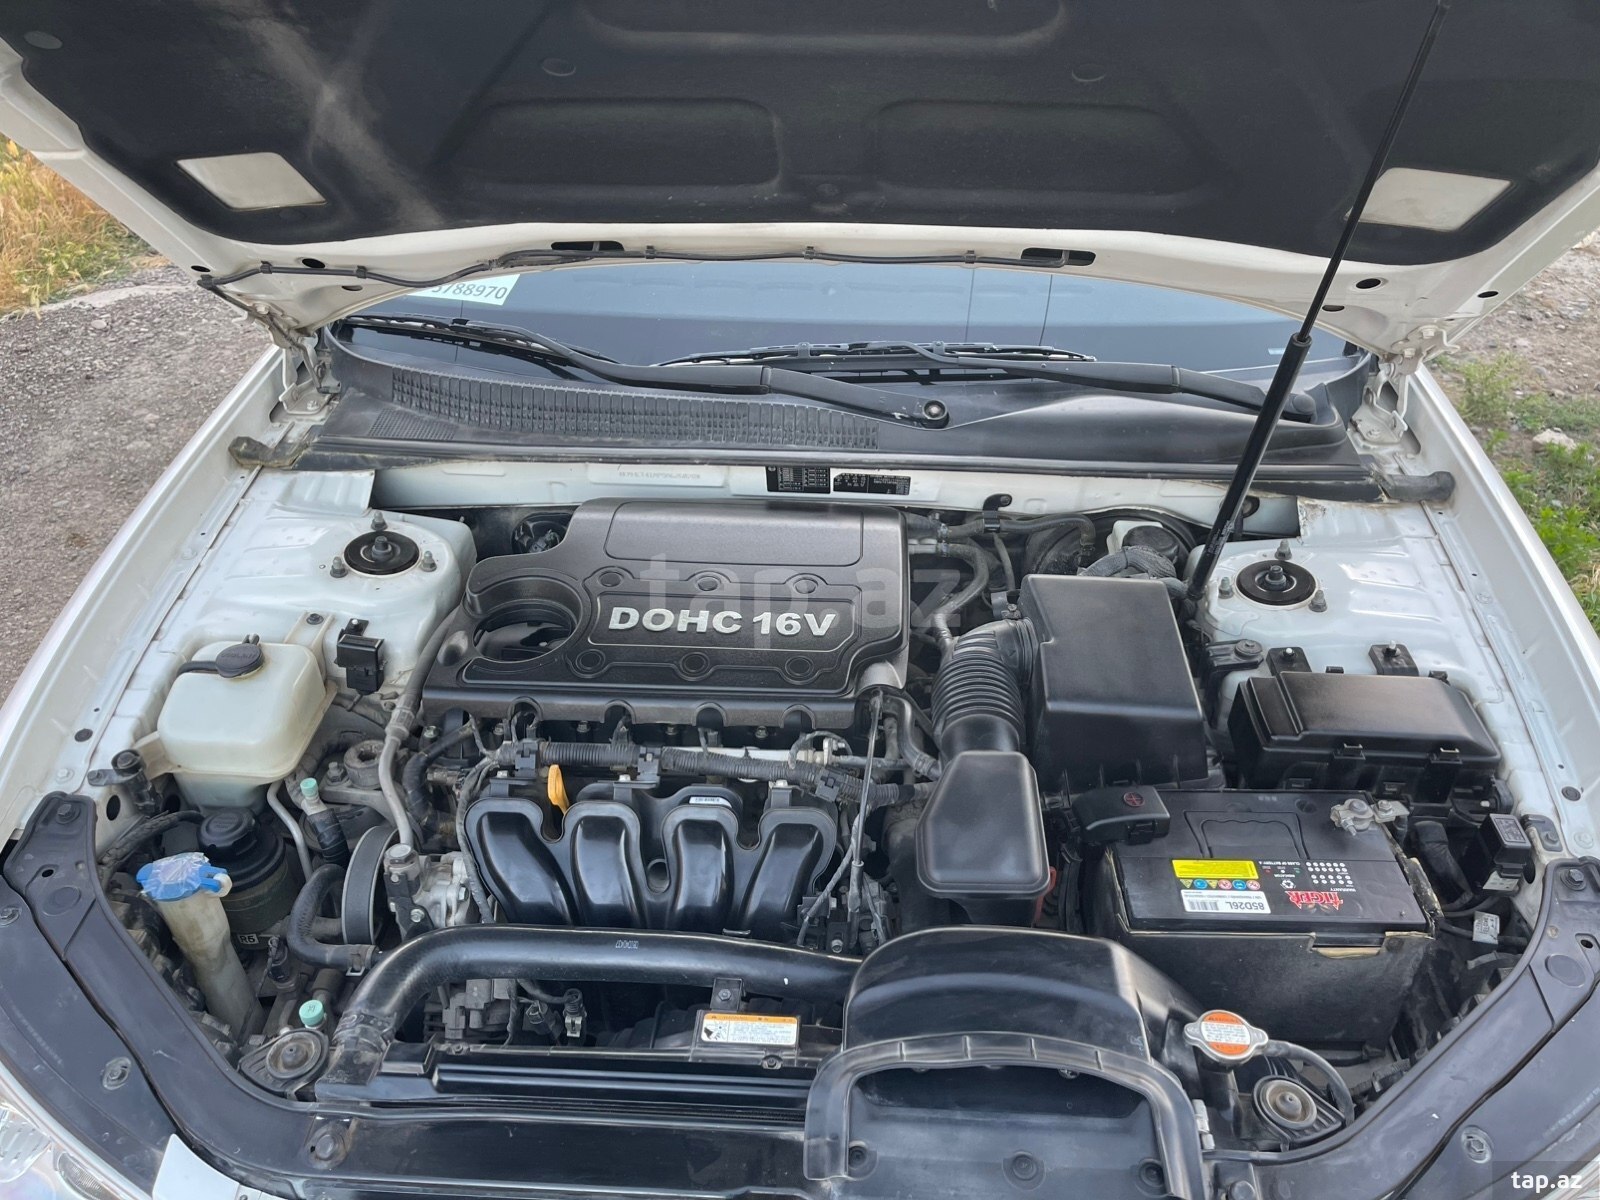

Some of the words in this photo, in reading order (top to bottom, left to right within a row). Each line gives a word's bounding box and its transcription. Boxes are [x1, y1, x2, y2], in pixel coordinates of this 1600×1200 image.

[608, 607, 743, 634] DOHC
[752, 612, 837, 637] 16V
[1225, 901, 1265, 911] 85D26L
[1284, 890, 1344, 910] TIGER
